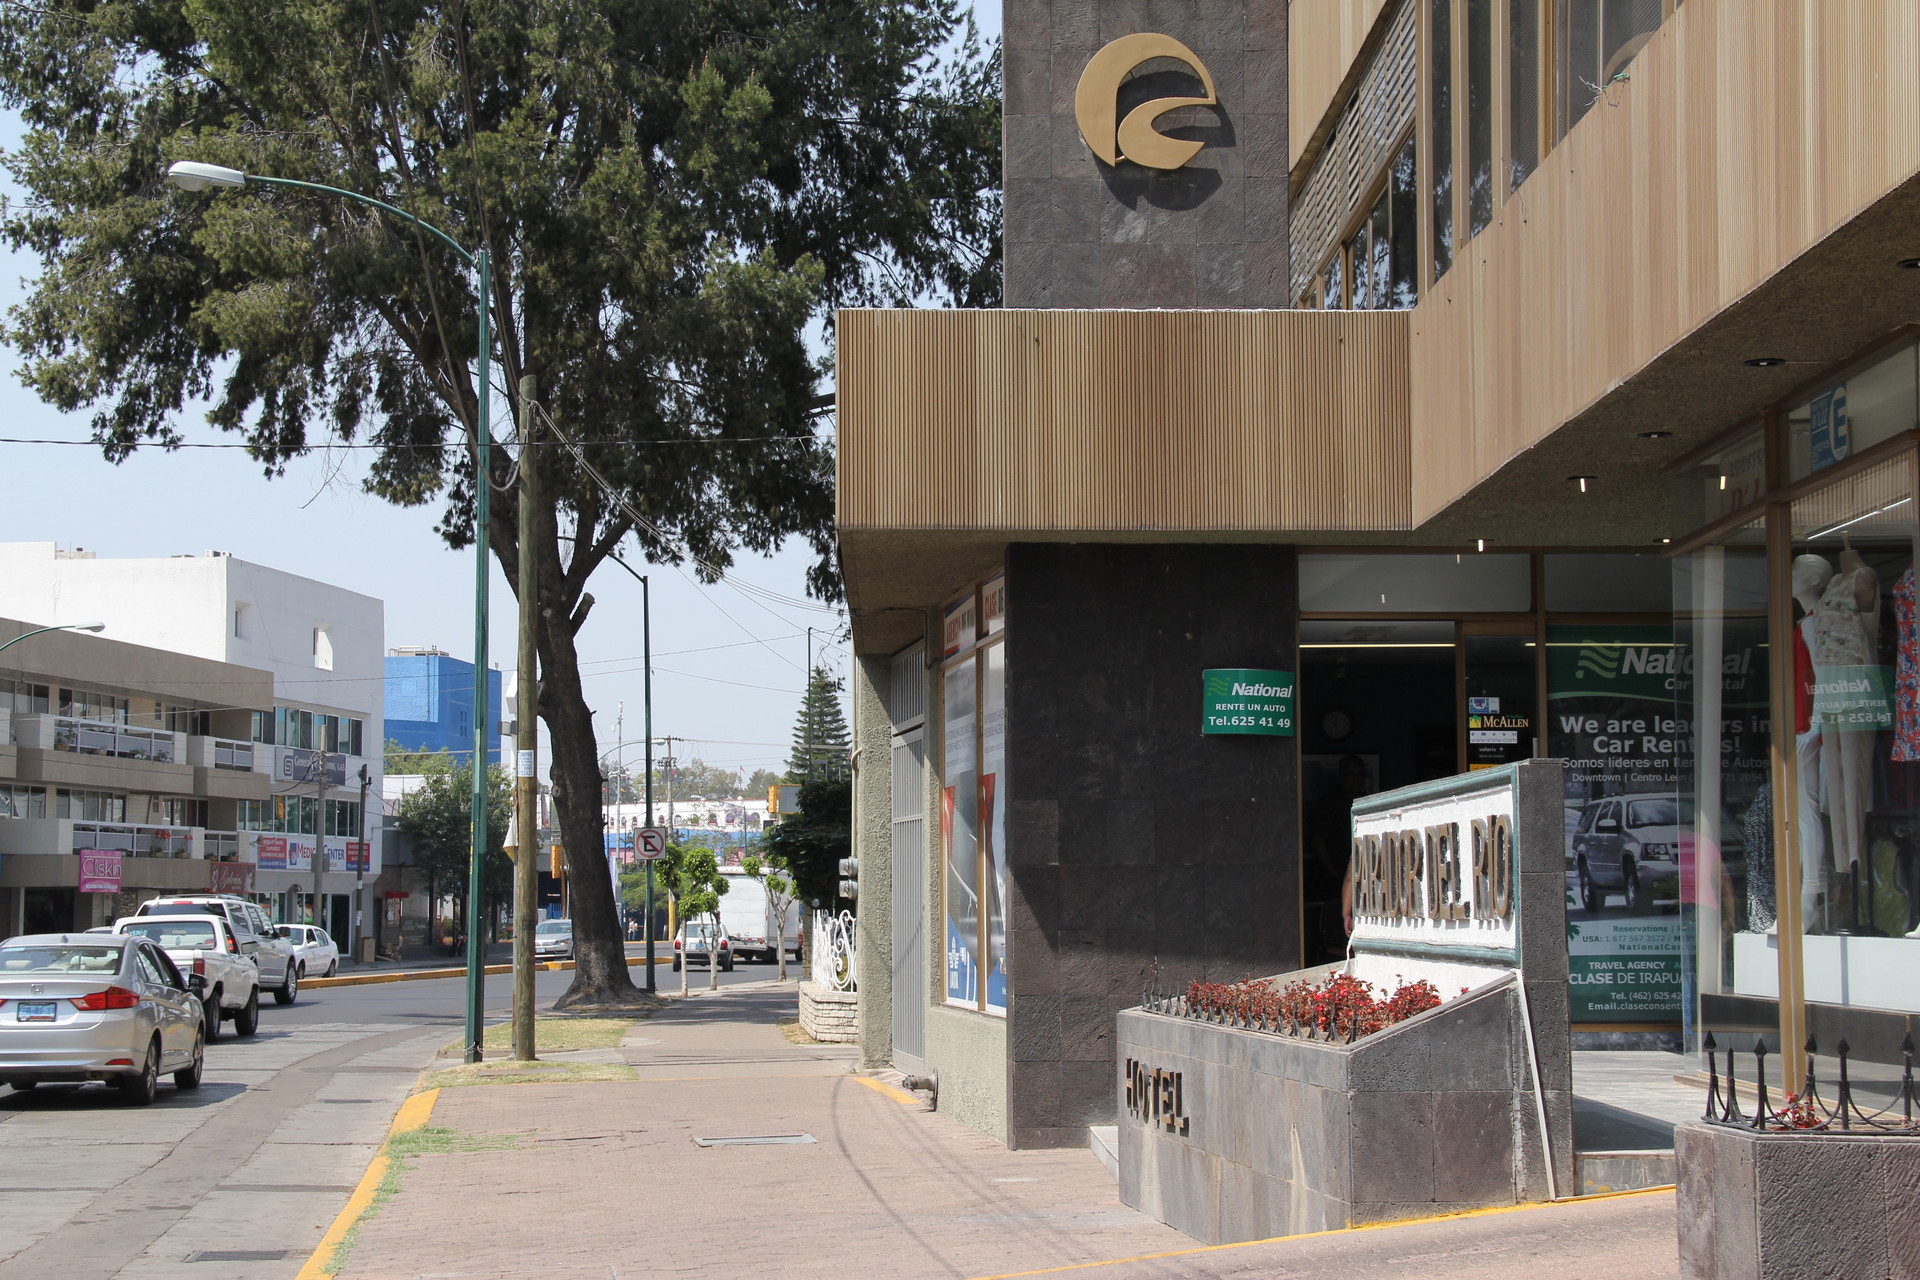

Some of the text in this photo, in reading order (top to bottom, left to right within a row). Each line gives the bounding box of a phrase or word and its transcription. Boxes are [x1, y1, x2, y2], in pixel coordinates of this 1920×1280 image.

[1621, 647, 1751, 675] Natioal
[1664, 678, 1690, 690] Car
[1231, 682, 1293, 699] National
[1215, 703, 1286, 713] RENTE UN AUTO
[1208, 716, 1291, 728] Tel.625 41 49
[1560, 716, 1599, 733] We
[1606, 719, 1646, 733] are
[1654, 715, 1743, 733] lears
[1593, 736, 1741, 753] Car Rents!
[1563, 757, 1604, 768] Somos
[1608, 757, 1650, 768] líderes
[1654, 759, 1669, 768] en
[1733, 757, 1768, 768] Autos
[1572, 773, 1621, 782] Downtown
[1630, 772, 1662, 782] Centro
[1353, 814, 1513, 921] PARADOR DEL RIO
[1588, 961, 1625, 970] TRAVEL
[1627, 961, 1666, 970] AGENCY
[1569, 973, 1614, 985] CLASE
[1617, 972, 1635, 984] DE
[1610, 992, 1627, 1000] Tel.
[1629, 991, 1652, 1001] (462)
[1653, 991, 1670, 1000] 625
[1126, 1058, 1189, 1132] HOTEL
